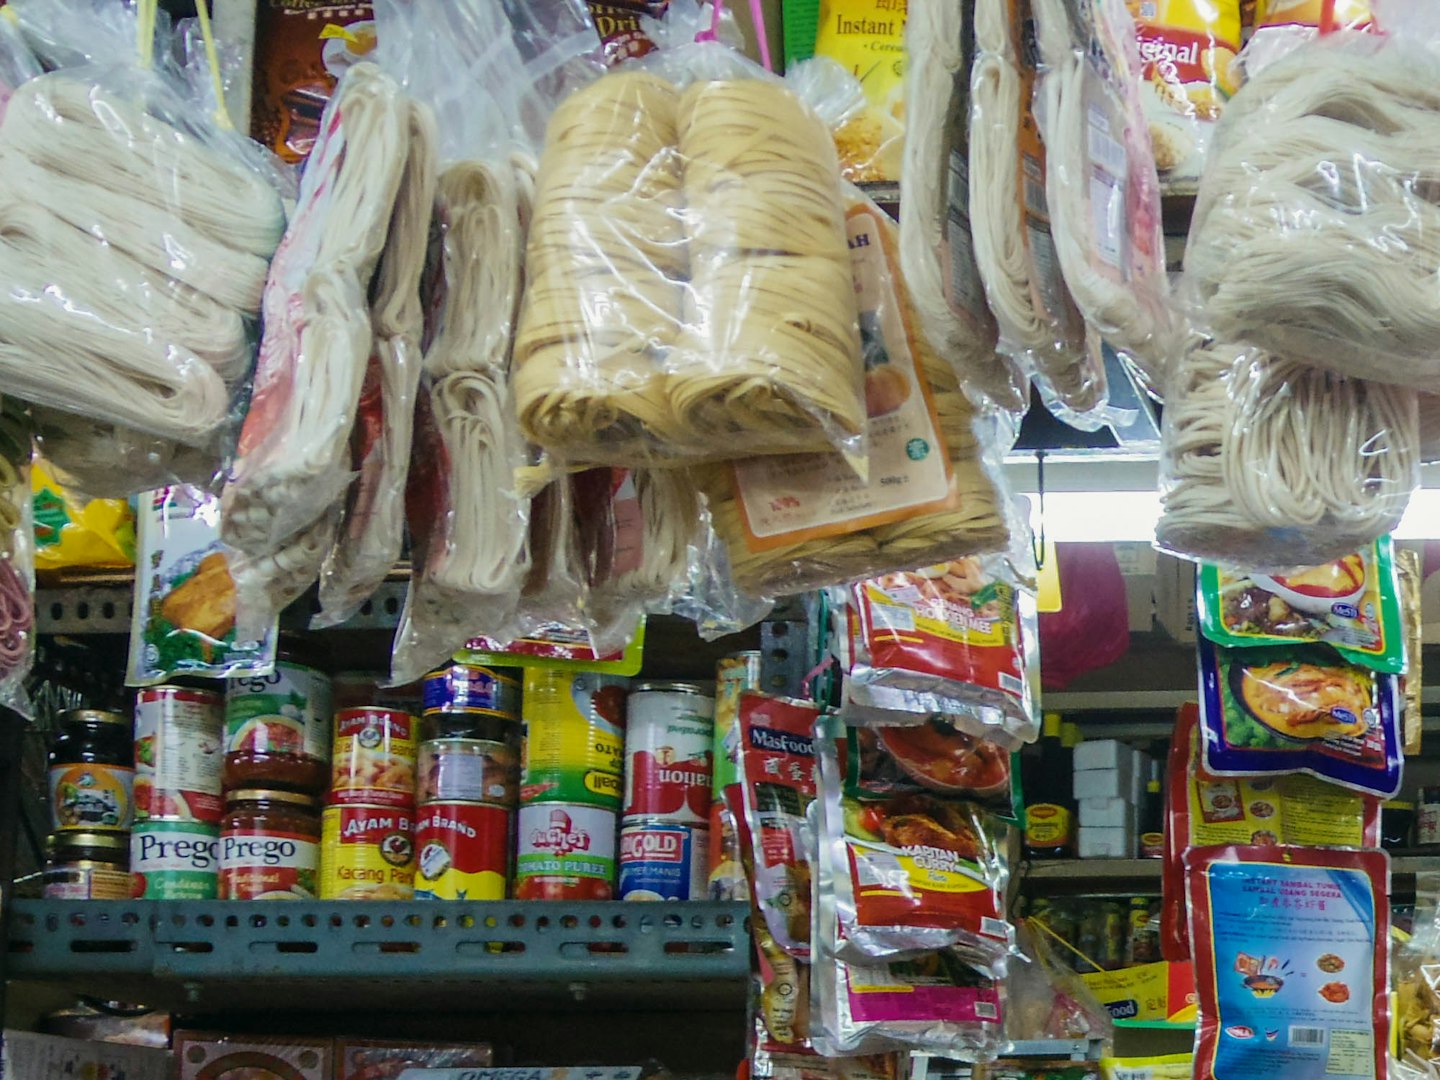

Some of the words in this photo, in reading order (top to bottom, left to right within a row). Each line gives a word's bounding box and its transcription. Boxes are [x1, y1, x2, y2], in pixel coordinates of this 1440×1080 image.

[836, 18, 895, 37] Instant
[967, 619, 993, 634] MEE
[344, 817, 393, 836] AYAM
[432, 815, 477, 838] BRAND
[223, 838, 296, 864] Prego
[902, 845, 960, 862] KAPITAN
[565, 861, 607, 873] PUREE
[913, 855, 957, 872] CURRY
[338, 865, 385, 883] Kacang
